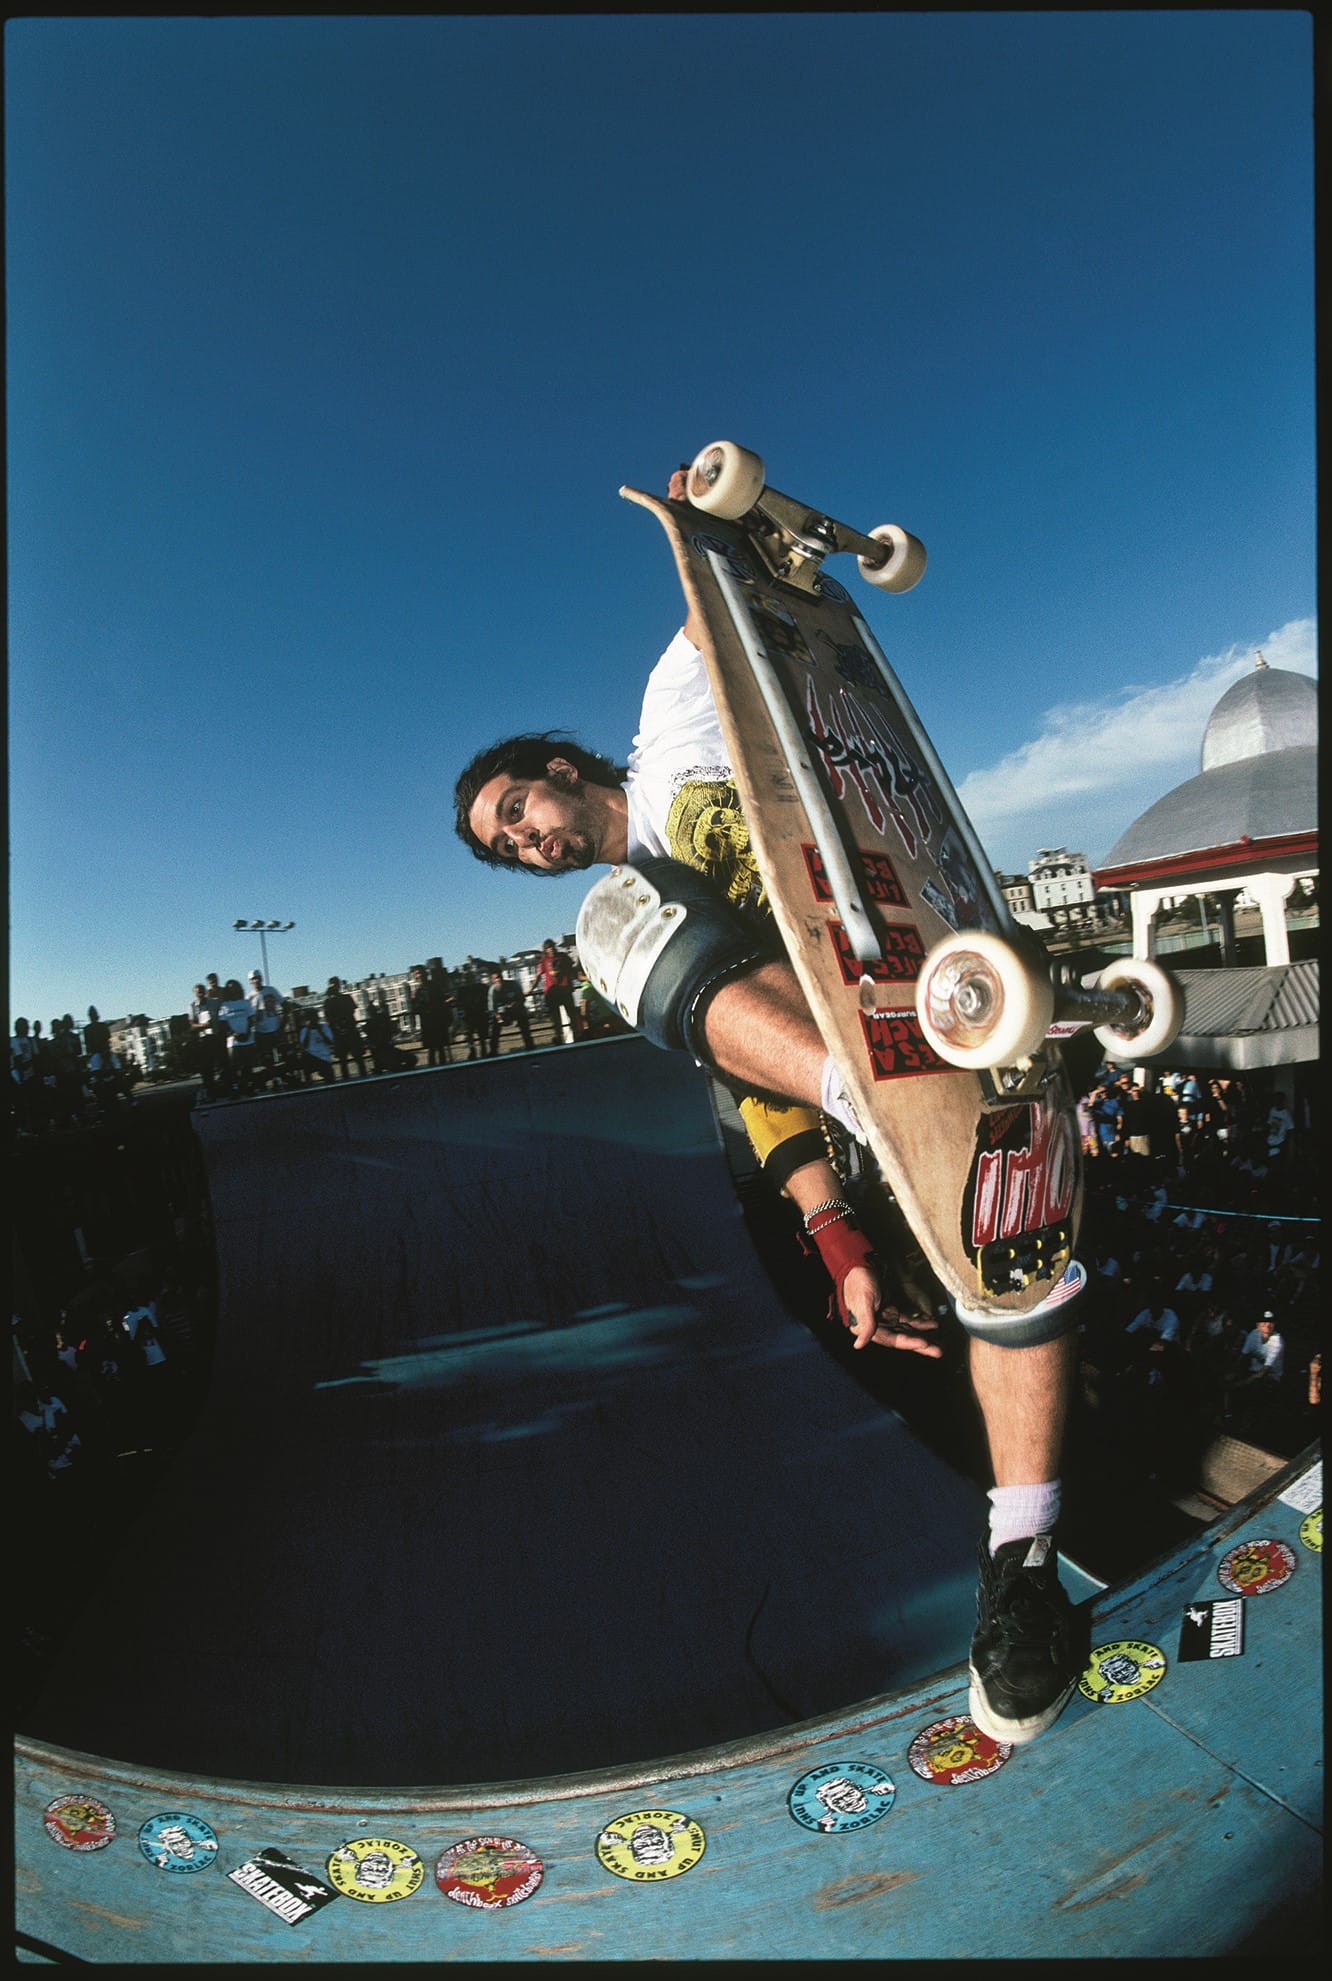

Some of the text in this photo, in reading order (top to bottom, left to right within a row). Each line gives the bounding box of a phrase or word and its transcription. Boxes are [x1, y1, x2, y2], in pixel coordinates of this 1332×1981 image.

[871, 1019, 922, 1047] ACH
[873, 1047, 895, 1071] A
[1209, 1599, 1238, 1658] SKATEBOX
[1094, 1643, 1120, 1657] AND
[1116, 1674, 1160, 1701] ZORLAC
[793, 1764, 886, 1825] SHUT UP AND SKATE
[615, 1812, 674, 1828] ZORLAC
[839, 1800, 890, 1831] ZORLAC
[357, 1840, 409, 1855] ZORLAC
[687, 1827, 702, 1853] SHUT
[170, 1855, 211, 1872] ZORLAC
[634, 1869, 669, 1879] AND
[677, 1857, 694, 1871] UP
[406, 1867, 422, 1891] SHUT
[231, 1862, 312, 1924] SKATEBOX
[347, 1888, 376, 1901] AND
[385, 1891, 403, 1900] UP
[447, 1886, 504, 1909] deathbox
